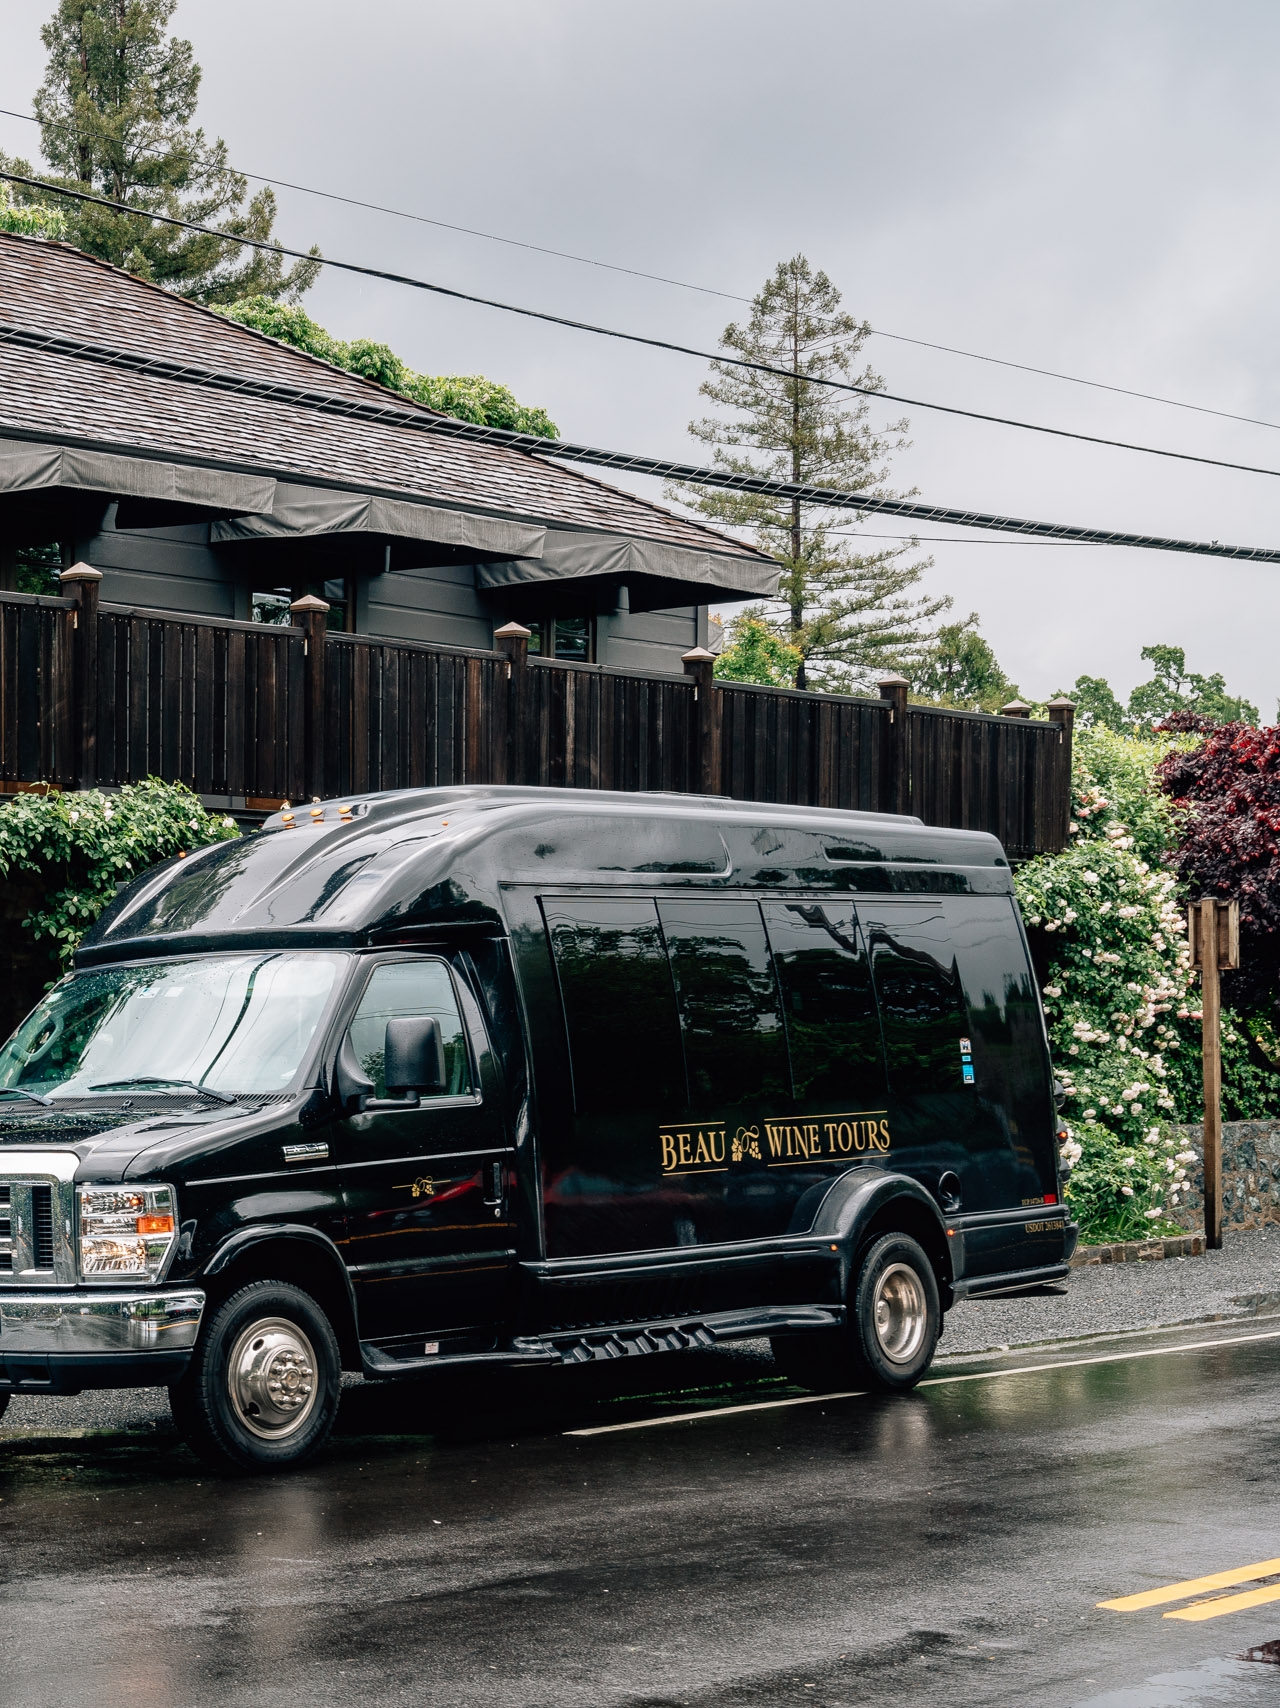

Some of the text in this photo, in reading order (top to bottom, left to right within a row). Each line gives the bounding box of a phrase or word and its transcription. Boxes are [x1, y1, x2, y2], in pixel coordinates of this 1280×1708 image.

[659, 1119, 892, 1171] BEAU WINE TOURS
[1025, 1222, 1045, 1233] USDOT
